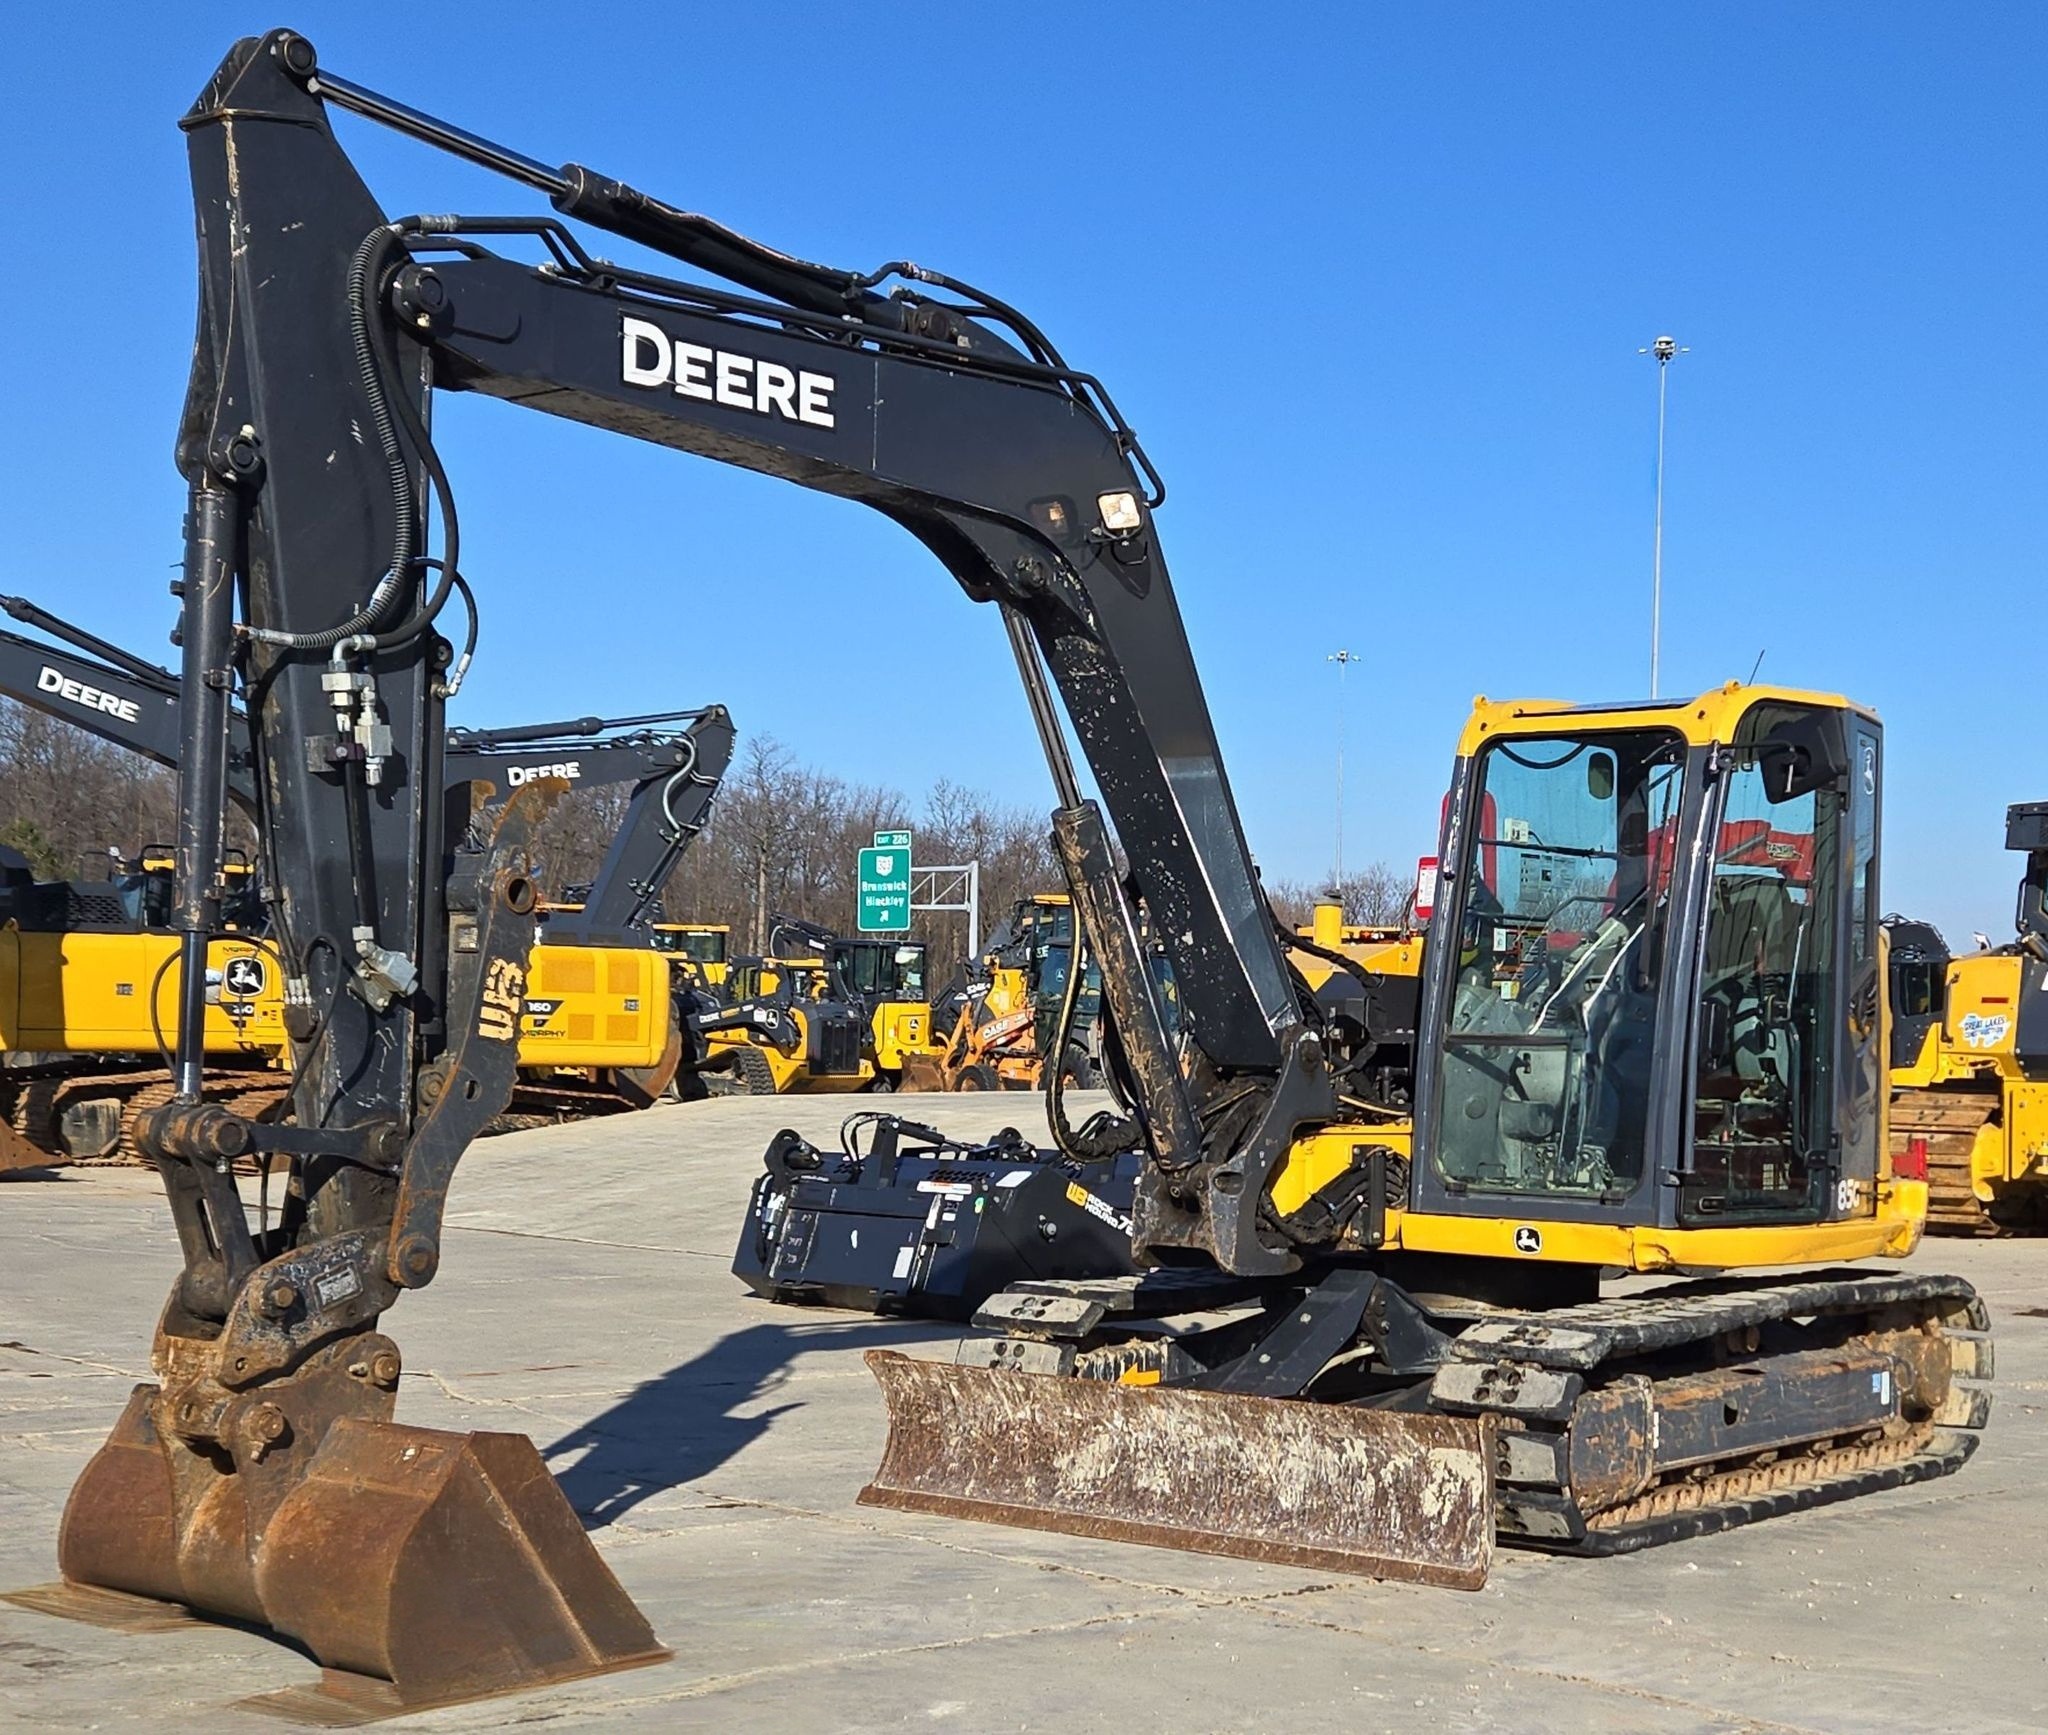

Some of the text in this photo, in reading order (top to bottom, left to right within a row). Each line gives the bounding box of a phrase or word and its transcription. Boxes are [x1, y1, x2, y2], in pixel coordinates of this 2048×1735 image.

[622, 315, 836, 428] DEERE
[37, 665, 141, 724] DEERE
[892, 834, 908, 845] 226
[861, 880, 908, 892] Brunswick
[865, 895, 905, 907] Hinckley
[527, 1001, 551, 1013] 160
[982, 1020, 1009, 1040] CASE
[1087, 1193, 1114, 1216] ROCK
